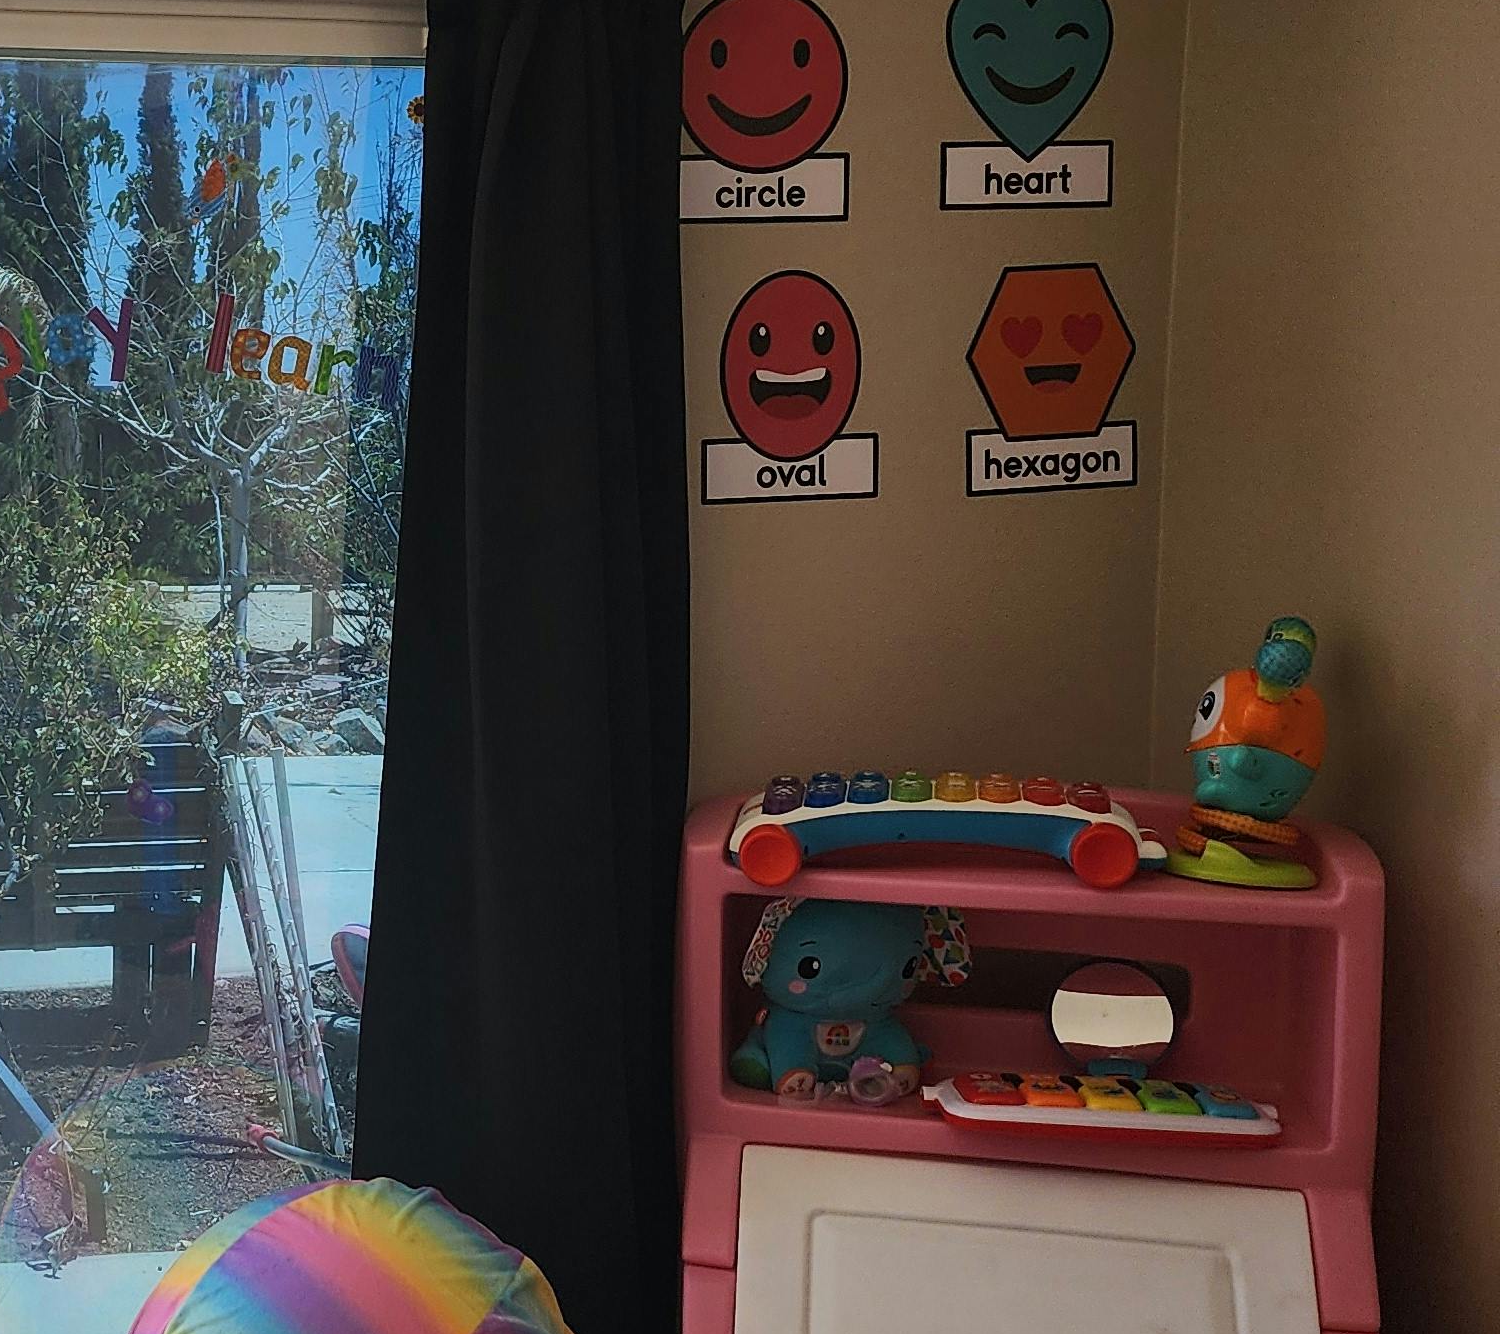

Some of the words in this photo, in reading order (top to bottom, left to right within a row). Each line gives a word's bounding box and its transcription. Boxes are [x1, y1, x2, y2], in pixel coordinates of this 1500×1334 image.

[714, 176, 806, 209] circle
[983, 163, 1072, 195] heart
[205, 293, 401, 411] learn
[756, 455, 827, 489] oval
[983, 448, 1120, 483] hexagon
